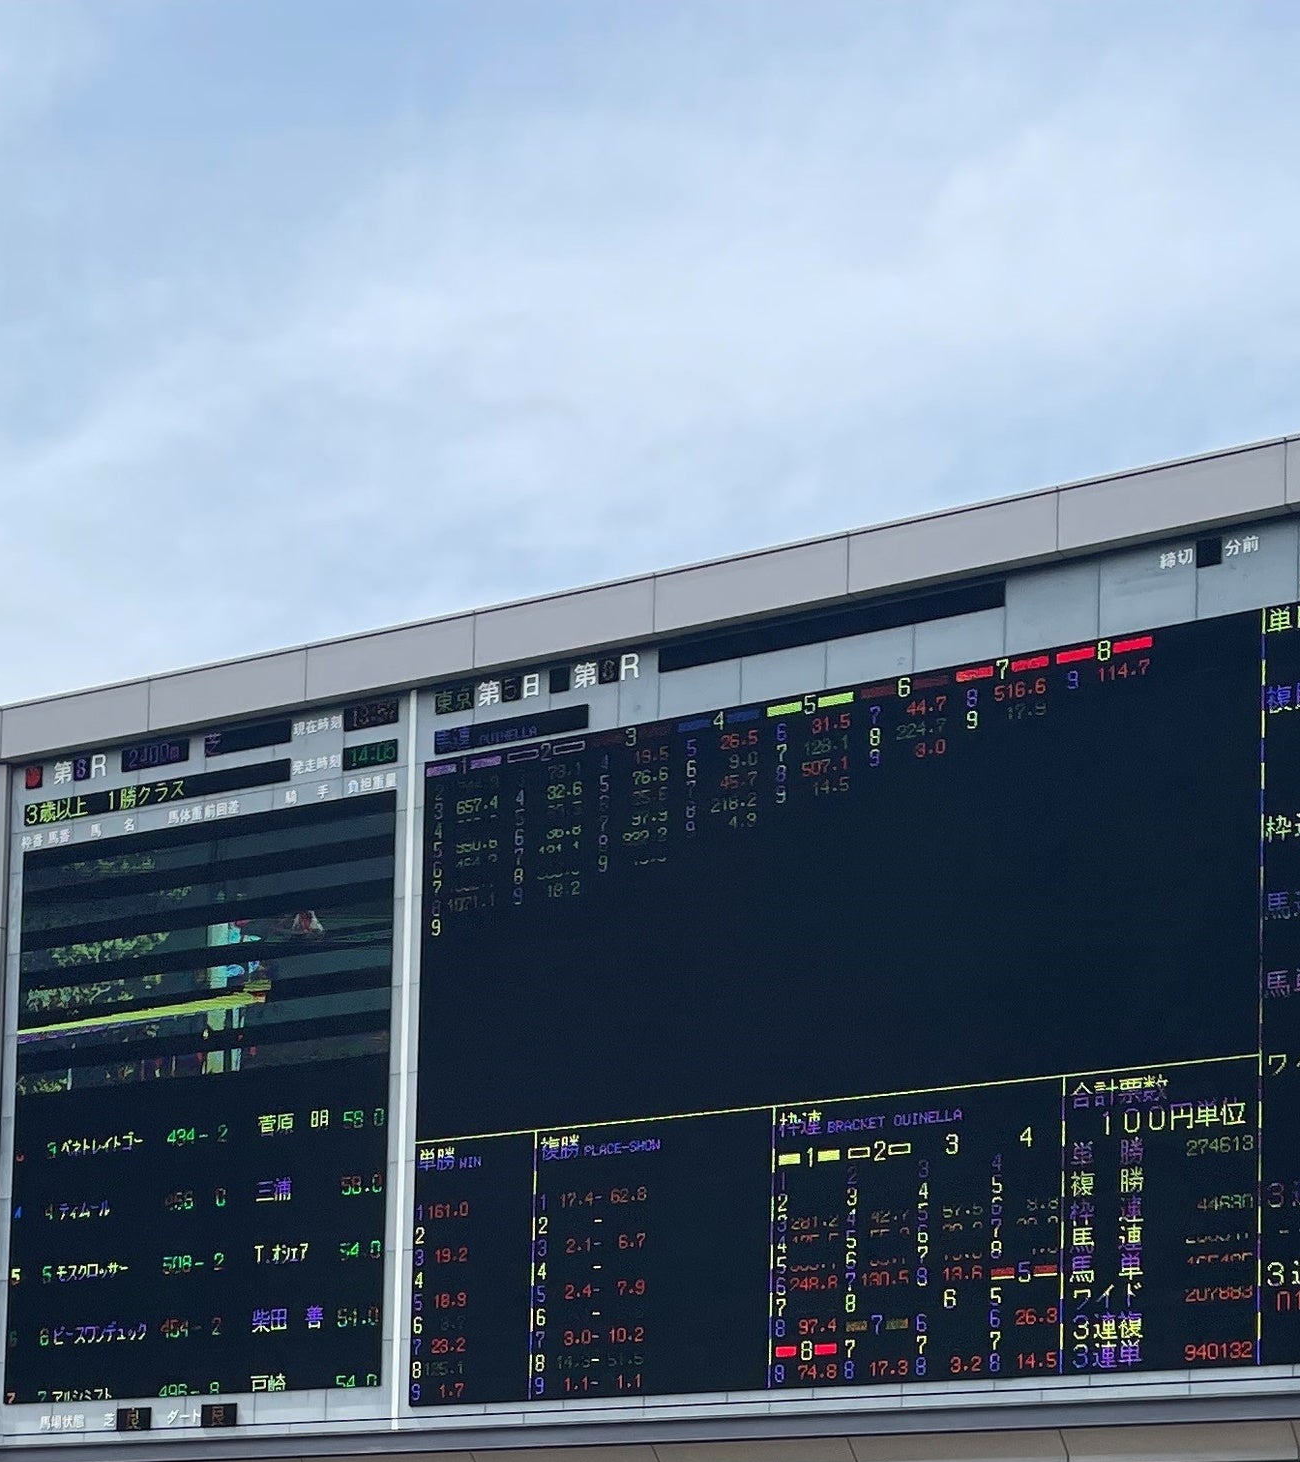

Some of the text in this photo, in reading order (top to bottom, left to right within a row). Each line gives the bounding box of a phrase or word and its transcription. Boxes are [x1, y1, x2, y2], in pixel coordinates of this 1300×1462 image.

[1225, 535, 1259, 557] 分前
[1097, 640, 1110, 661] 8
[996, 659, 1008, 679] 7
[1099, 659, 1149, 681] 114.7
[898, 677, 911, 697] 6
[994, 678, 1046, 701] 516.6
[804, 695, 816, 715] 5
[907, 697, 946, 715] 44.7
[293, 715, 342, 736] 現在時刻
[714, 711, 724, 730] 4
[812, 714, 849, 734] 31.5
[967, 711, 978, 728] 9
[625, 728, 637, 746] 3
[870, 728, 880, 745] 8
[777, 745, 787, 762] 7
[292, 755, 341, 775] 発走時刻
[687, 760, 696, 777] 6
[347, 773, 397, 794] 負担重量
[26, 781, 184, 824] 3歳以上 1勝クラス
[432, 919, 441, 936] 9
[258, 1109, 328, 1136] 菅原 明
[827, 1116, 885, 1133] BRACKET
[894, 1109, 963, 1126] QUINELLA
[584, 1139, 661, 1157] PLACE-SHOW
[807, 1127, 1033, 1167] 1 2 3 4
[1186, 1135, 1254, 1156] 274613
[256, 1177, 292, 1201] 三浦
[919, 1182, 929, 1199] 4
[418, 1201, 468, 1220] 1 161.0
[778, 1194, 788, 1212] 2
[538, 1217, 548, 1234] 2
[538, 1233, 645, 1256] 3 6.7
[11, 1268, 21, 1285] 5
[538, 1262, 546, 1279] 4
[537, 1280, 645, 1302] 5 7.9
[944, 1289, 956, 1309] 6
[776, 1298, 786, 1316] 7
[845, 1294, 855, 1312] 8
[252, 1308, 288, 1333] 柴田
[306, 1305, 324, 1329] 善
[537, 1308, 546, 1326] 6
[871, 1315, 882, 1335] 7
[916, 1314, 927, 1332] 6
[990, 1308, 1057, 1328] 6 26.3
[775, 1318, 836, 1337] 8 97.4
[537, 1331, 545, 1348] 7
[845, 1339, 855, 1358] 7
[916, 1336, 927, 1354] 7
[990, 1332, 1000, 1350] 7
[801, 1340, 812, 1360] 8
[1185, 1341, 1252, 1361] 940132
[535, 1354, 545, 1371] 8
[798, 1364, 837, 1379] 74.8
[844, 1359, 908, 1379] 8 17.3
[916, 1356, 981, 1375] 8 3.2
[990, 1352, 1057, 1372] 8 14.5
[251, 1373, 287, 1392] 戸崎
[439, 1383, 464, 1398] 1.7
[535, 1374, 641, 1394] 9 1.1
[39, 1414, 85, 1430] 馬場状態
